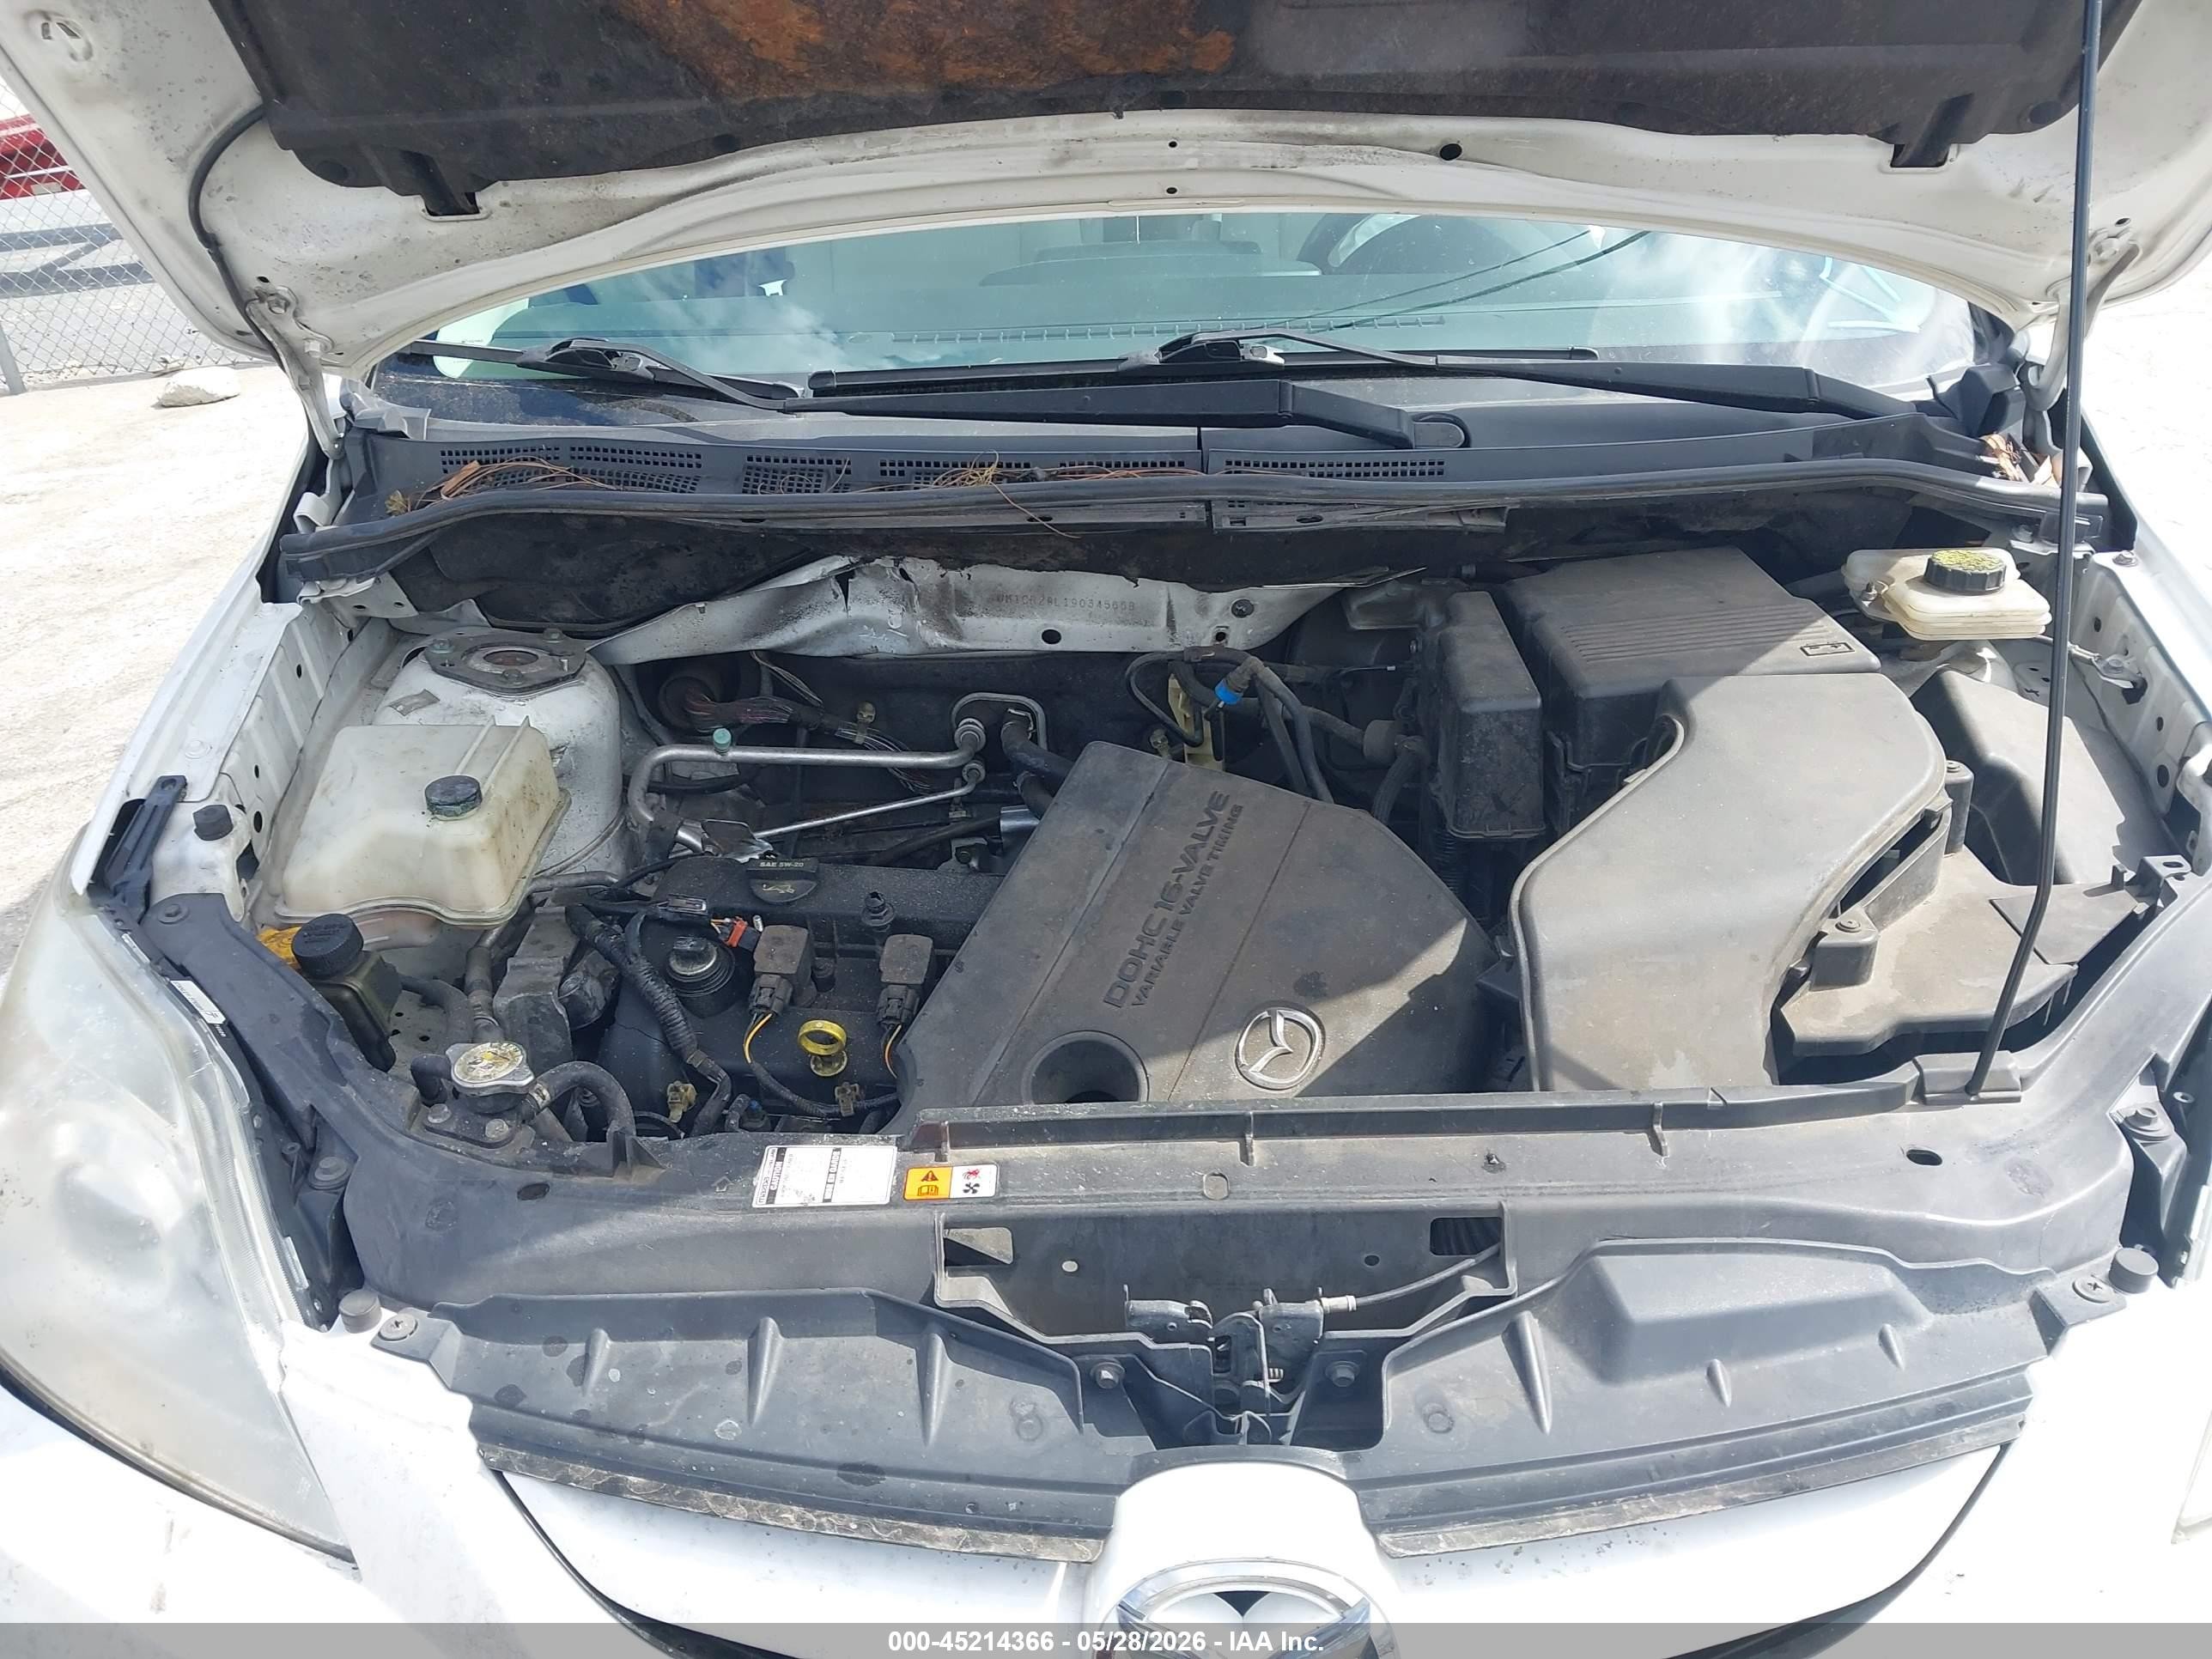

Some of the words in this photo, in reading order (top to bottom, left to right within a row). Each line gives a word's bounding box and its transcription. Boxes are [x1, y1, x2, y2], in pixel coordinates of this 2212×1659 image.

[1103, 914, 1166, 1008] DOHC
[1154, 790, 1231, 911] 16-VALVE
[1132, 919, 1185, 1006] VARIABLE
[1179, 864, 1214, 915] VALVE
[1206, 804, 1243, 861] TIMING
[769, 1161, 783, 1191] CAUTION
